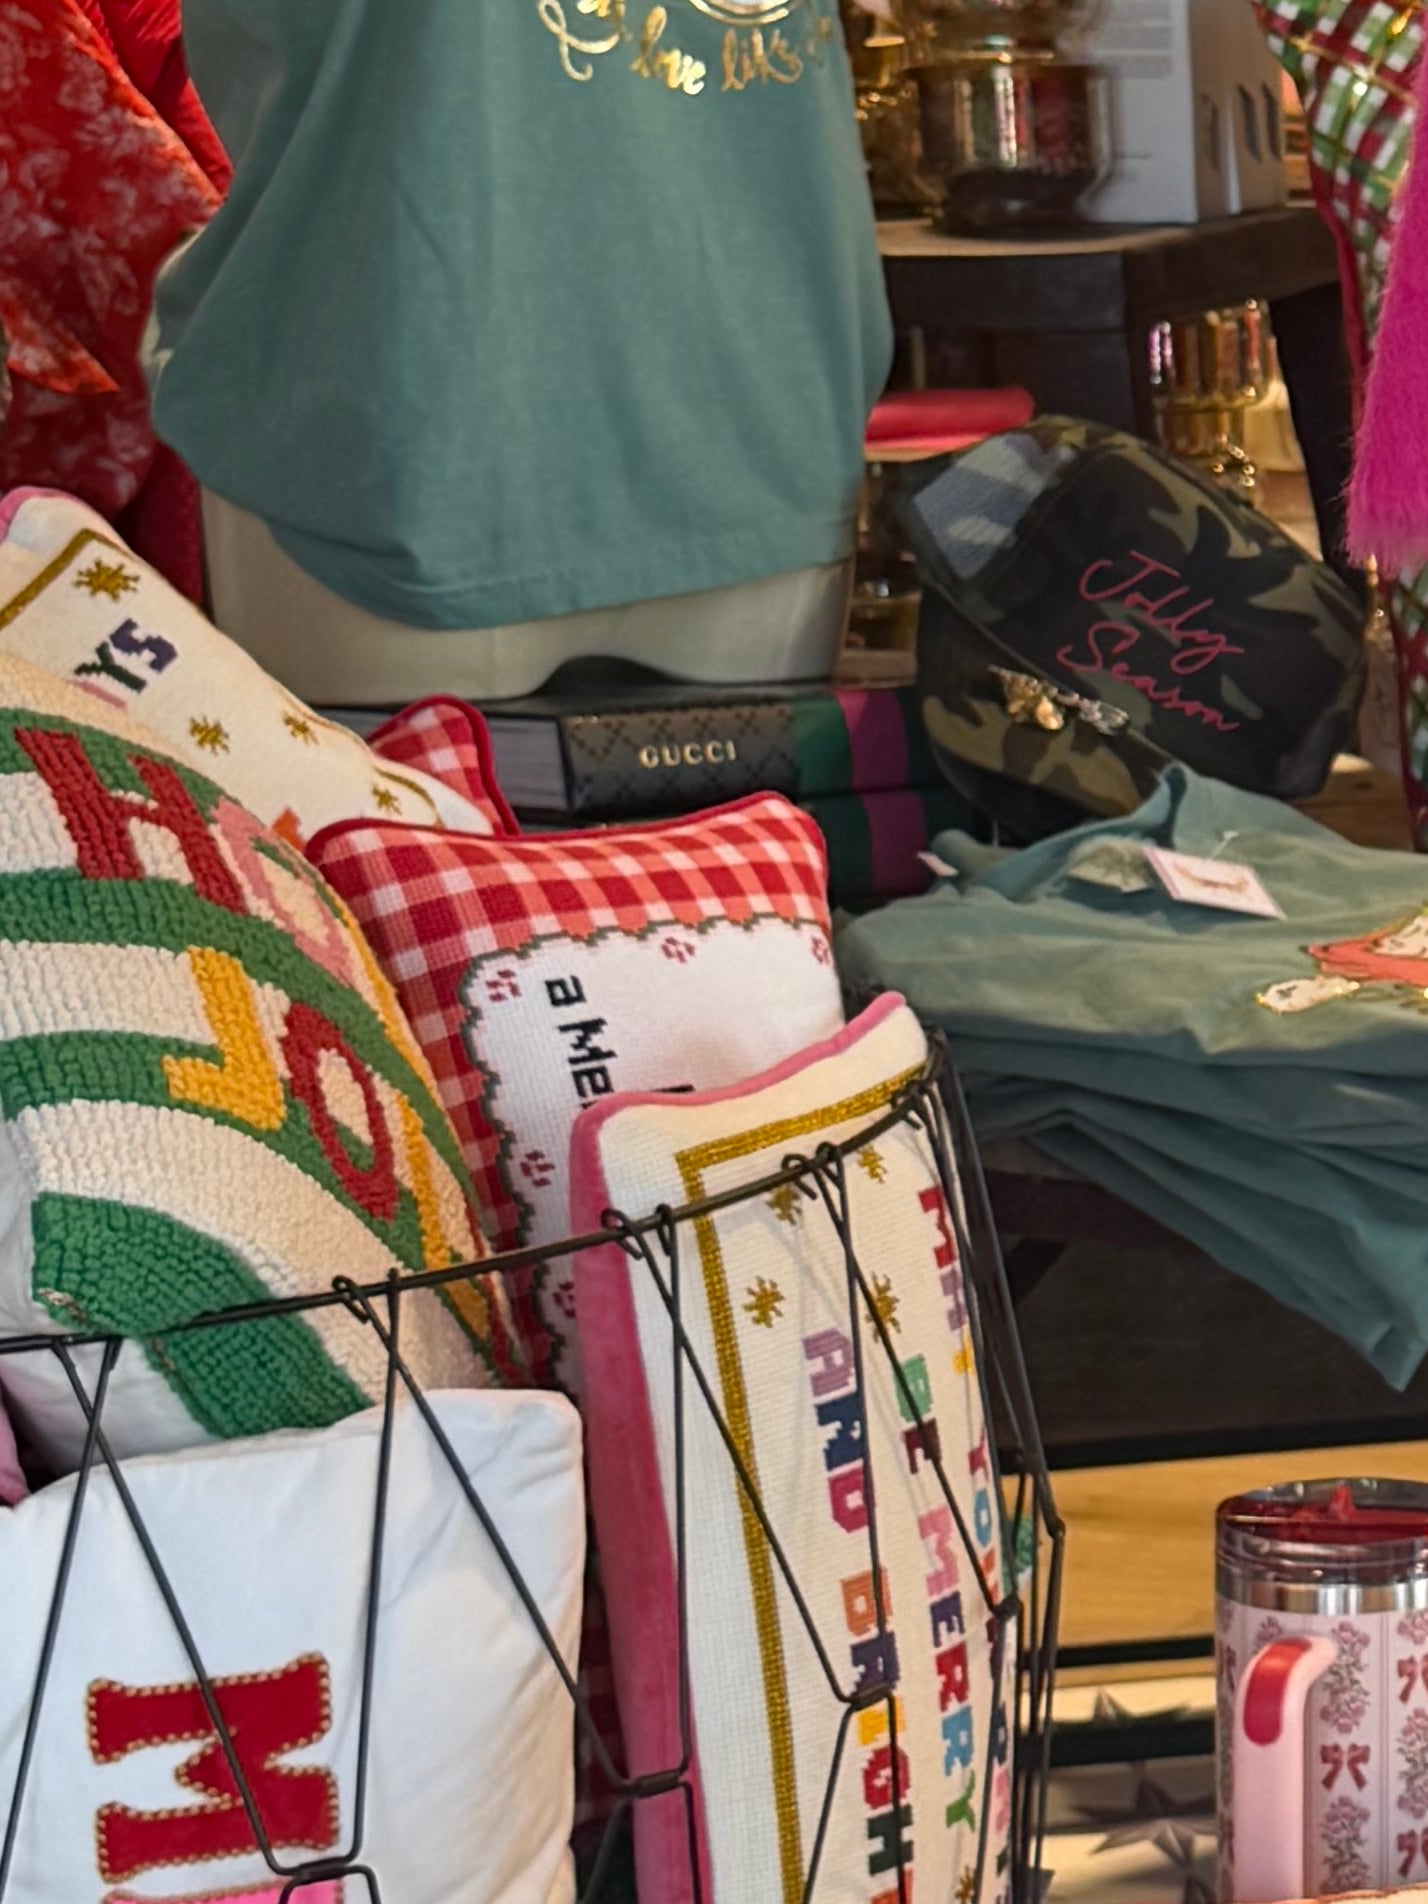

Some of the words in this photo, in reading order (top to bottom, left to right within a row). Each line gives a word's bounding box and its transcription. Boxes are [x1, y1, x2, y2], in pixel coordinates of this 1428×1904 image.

[65, 616, 180, 708] YS
[1077, 548, 1245, 676] Jolly
[1056, 621, 1240, 731] Season
[638, 739, 738, 769] GUCCI
[544, 974, 587, 1008] a
[557, 1017, 618, 1106] Me
[802, 1327, 877, 1534] AND
[894, 1353, 941, 1475] BE
[917, 1503, 977, 1834] MERRY
